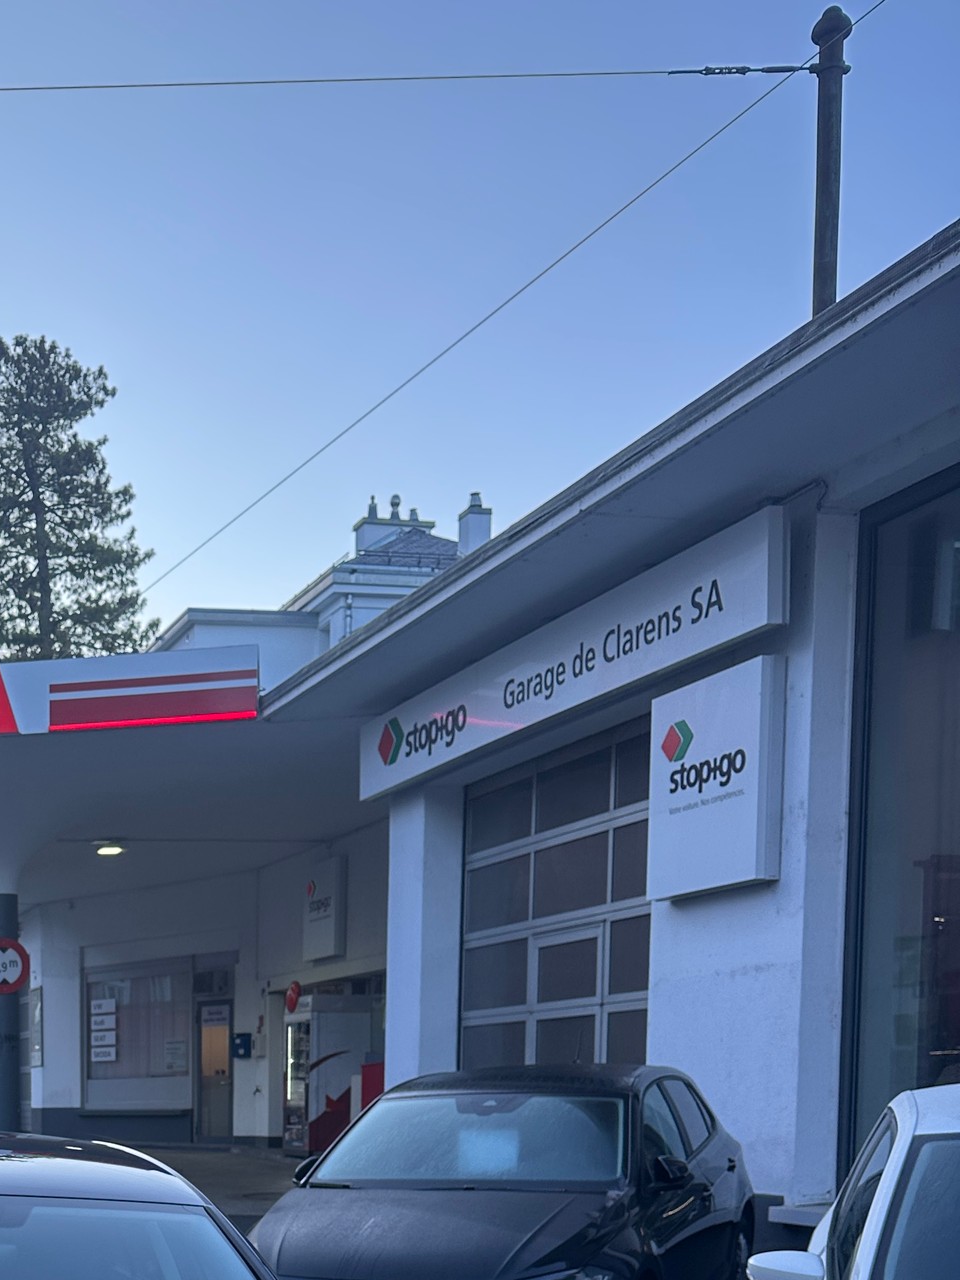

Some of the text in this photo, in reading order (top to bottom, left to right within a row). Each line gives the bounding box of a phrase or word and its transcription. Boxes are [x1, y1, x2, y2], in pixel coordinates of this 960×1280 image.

[503, 579, 724, 709] Garage de Clarens SA
[404, 704, 467, 758] stop+go
[669, 748, 746, 794] stop+go
